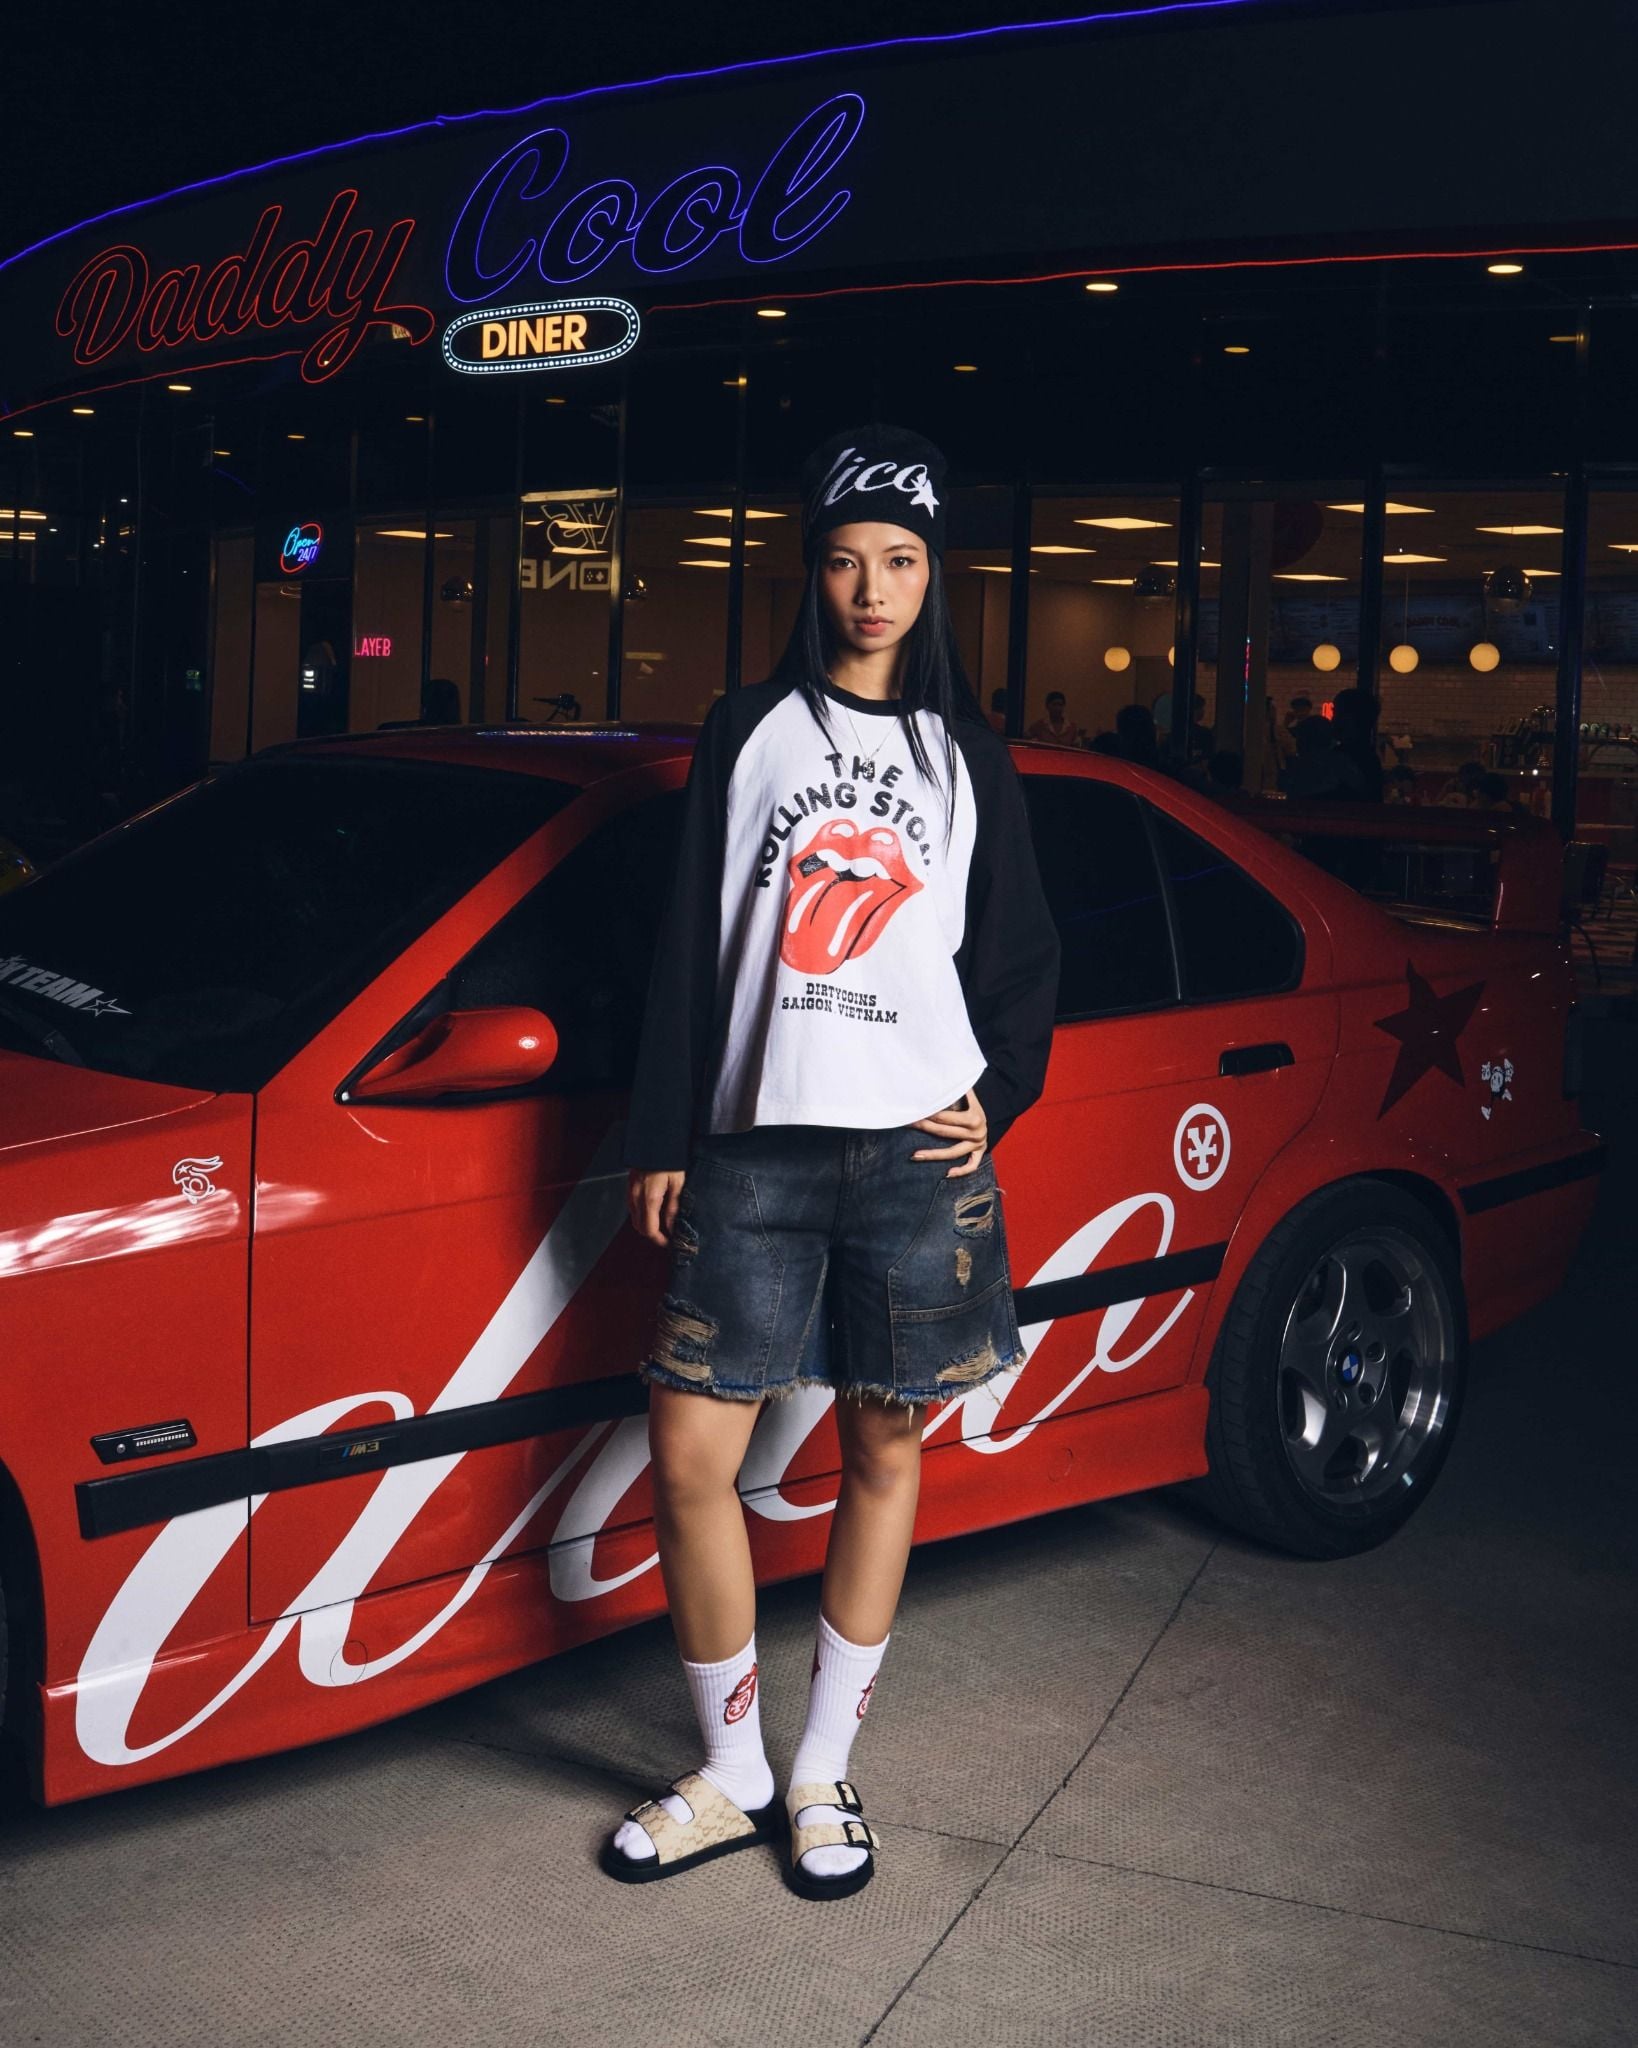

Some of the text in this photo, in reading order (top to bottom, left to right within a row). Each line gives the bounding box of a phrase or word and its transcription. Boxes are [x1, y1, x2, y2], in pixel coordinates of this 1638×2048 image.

[55, 93, 865, 384] Daddy Cool
[482, 313, 588, 360] DINER
[283, 526, 320, 557] Open
[824, 752, 903, 788] THE
[781, 996, 899, 1024] SAIGON VIETNAM
[806, 982, 877, 1008] DIRTYCOINS
